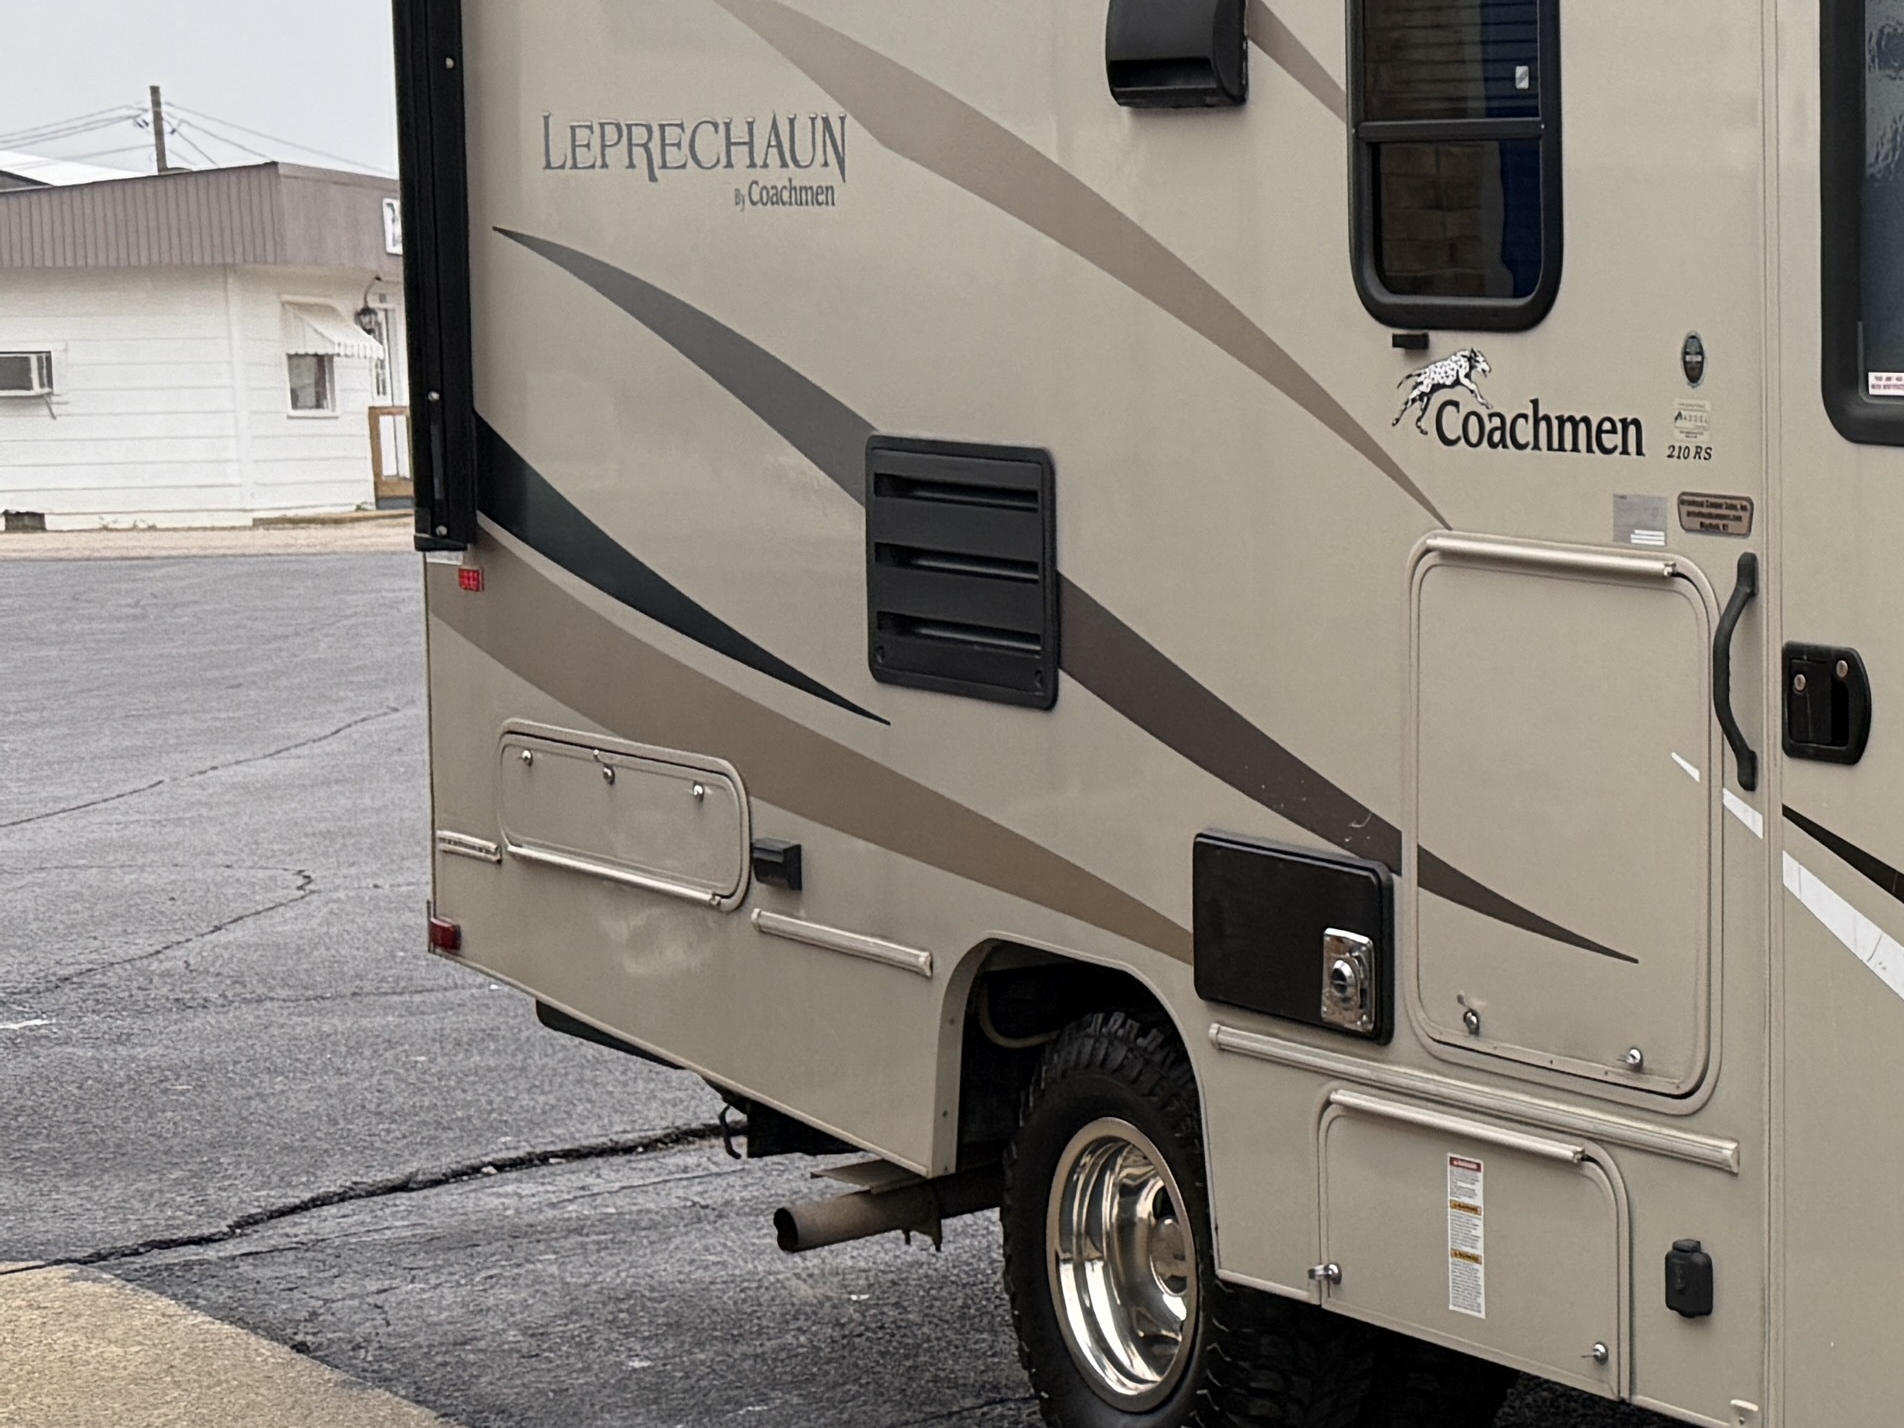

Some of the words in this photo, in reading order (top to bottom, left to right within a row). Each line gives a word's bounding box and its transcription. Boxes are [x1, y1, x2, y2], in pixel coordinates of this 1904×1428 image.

[542, 110, 847, 183] LEPRECHAUN
[734, 188, 746, 212] By
[748, 178, 835, 207] Coachmen
[1435, 398, 1646, 458] Coachmen
[1666, 443, 1691, 460] 210
[1693, 445, 1713, 461] RS
